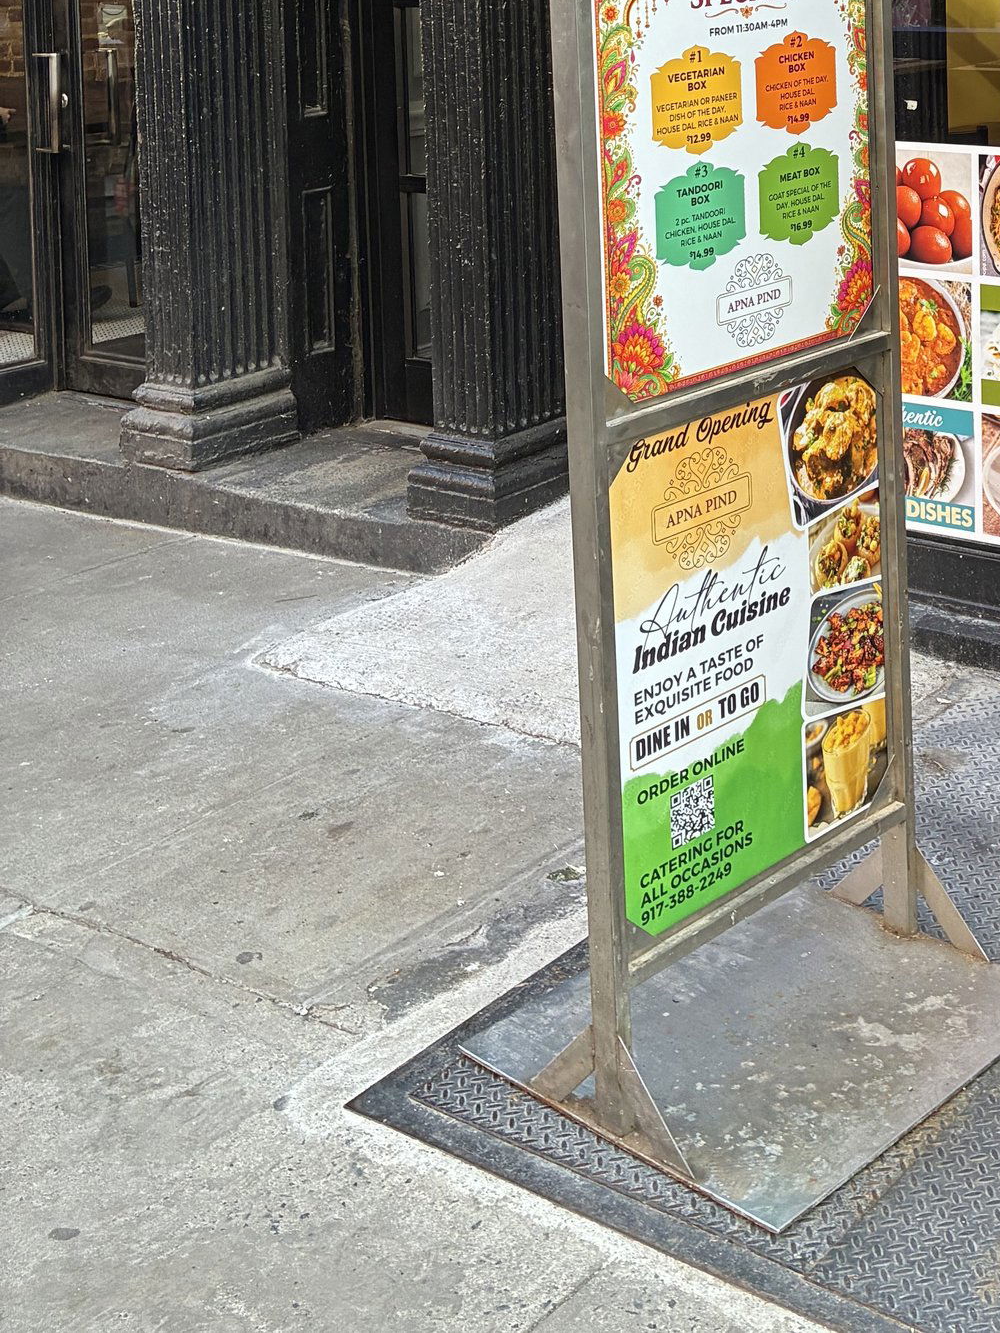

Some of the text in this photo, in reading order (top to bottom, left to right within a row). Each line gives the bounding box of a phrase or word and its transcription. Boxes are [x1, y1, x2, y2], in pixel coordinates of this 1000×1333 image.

[709, 18, 788, 37] FROM 11:30AM-4PM
[790, 35, 802, 48] #2
[689, 50, 702, 63] #1
[778, 51, 815, 64] CHICKEN
[668, 66, 725, 83] VEGETARIAN
[788, 63, 806, 73] BOX
[687, 80, 707, 91] BOX
[765, 80, 792, 92] CHICKEN
[793, 79, 802, 87] OF
[803, 76, 815, 85] THE
[656, 92, 738, 113] VEGETARIAN OR PANEER
[780, 90, 801, 100] HOUSE
[779, 102, 793, 111] RICE
[799, 98, 817, 108] NAAN
[669, 113, 686, 122] DISH
[687, 111, 696, 119] OF
[697, 108, 710, 116] THE
[787, 113, 810, 124] $14.99
[656, 126, 681, 136] HOUSE
[697, 118, 713, 127] RICE
[714, 117, 719, 125] &
[720, 114, 739, 124] NAAN
[686, 132, 712, 144] $12.99
[793, 146, 805, 158] #4
[694, 165, 708, 178] #3
[779, 166, 821, 183] MEAT BOX
[676, 180, 723, 198] TANDOORI
[768, 180, 832, 201] GOAT SPECIAL OF THE
[691, 194, 710, 206] BOX
[790, 196, 812, 207] HOUSE
[675, 218, 680, 226] 2
[691, 207, 726, 222] TANDOORI
[782, 211, 797, 220] RICE
[802, 205, 820, 215] NAAN
[697, 220, 721, 232] HOUSE
[790, 219, 813, 232] $16.99
[680, 231, 723, 247] RICE & NAAN
[689, 246, 715, 260] $14.99
[727, 288, 781, 314] APNA PIND
[626, 401, 774, 473] Grand Opening
[666, 490, 737, 529] APNA PIND
[906, 499, 973, 528] DISHES
[639, 545, 787, 637] Authentic
[632, 586, 791, 674] Indian Cuisine
[634, 634, 764, 707] ENJOY A TASTE OF
[634, 657, 754, 725] EXQUISITE FOOD
[635, 682, 759, 761] DINE IN OR TO GO
[637, 738, 745, 805] ORDER ONLINE
[639, 820, 744, 889] CATERING FOR
[640, 832, 753, 909] ALL OCCASIONS
[641, 861, 732, 926] 917-388-2249
